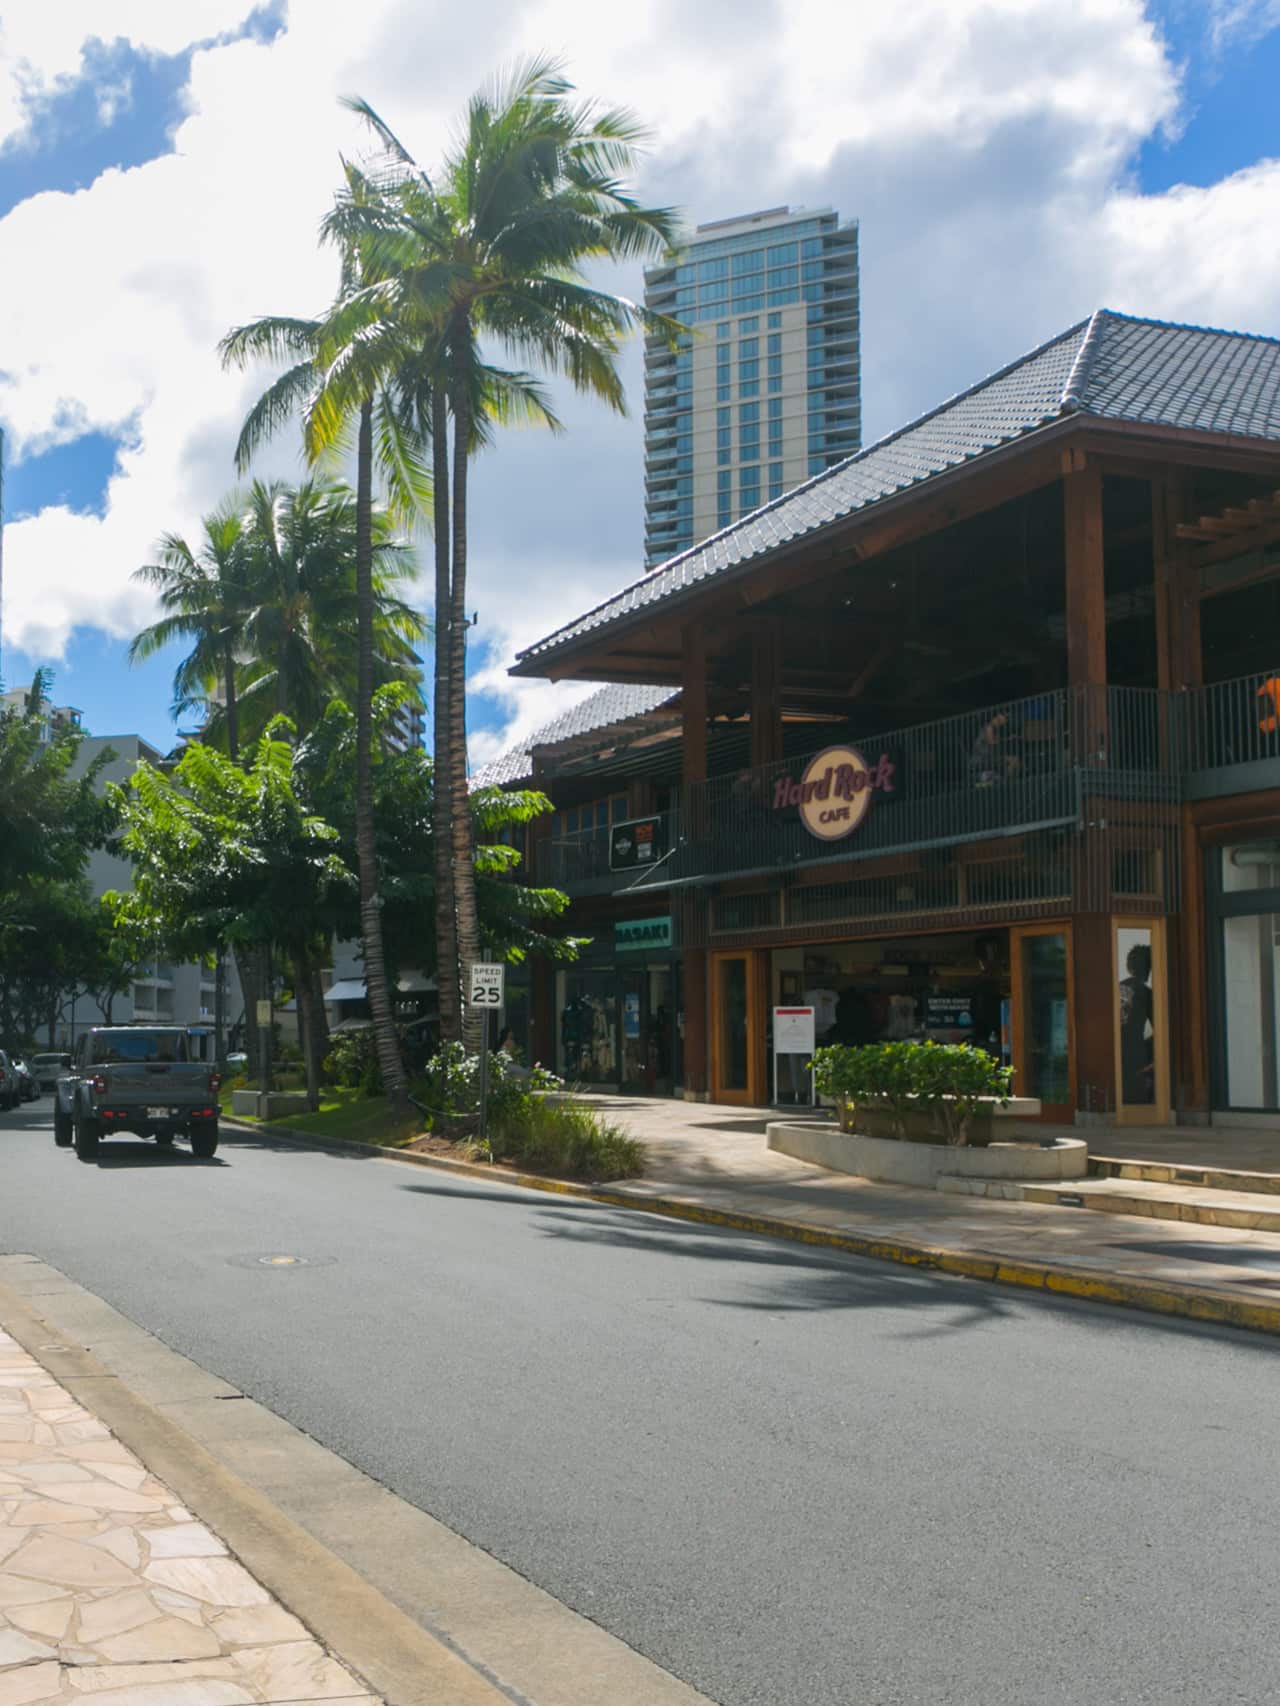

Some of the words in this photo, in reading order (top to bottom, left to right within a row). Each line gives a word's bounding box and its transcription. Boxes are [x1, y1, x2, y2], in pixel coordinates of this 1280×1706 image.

[773, 767, 833, 808] Hard
[834, 754, 896, 801] Rock
[819, 807, 850, 824] CAFE
[473, 986, 500, 1003] 25
